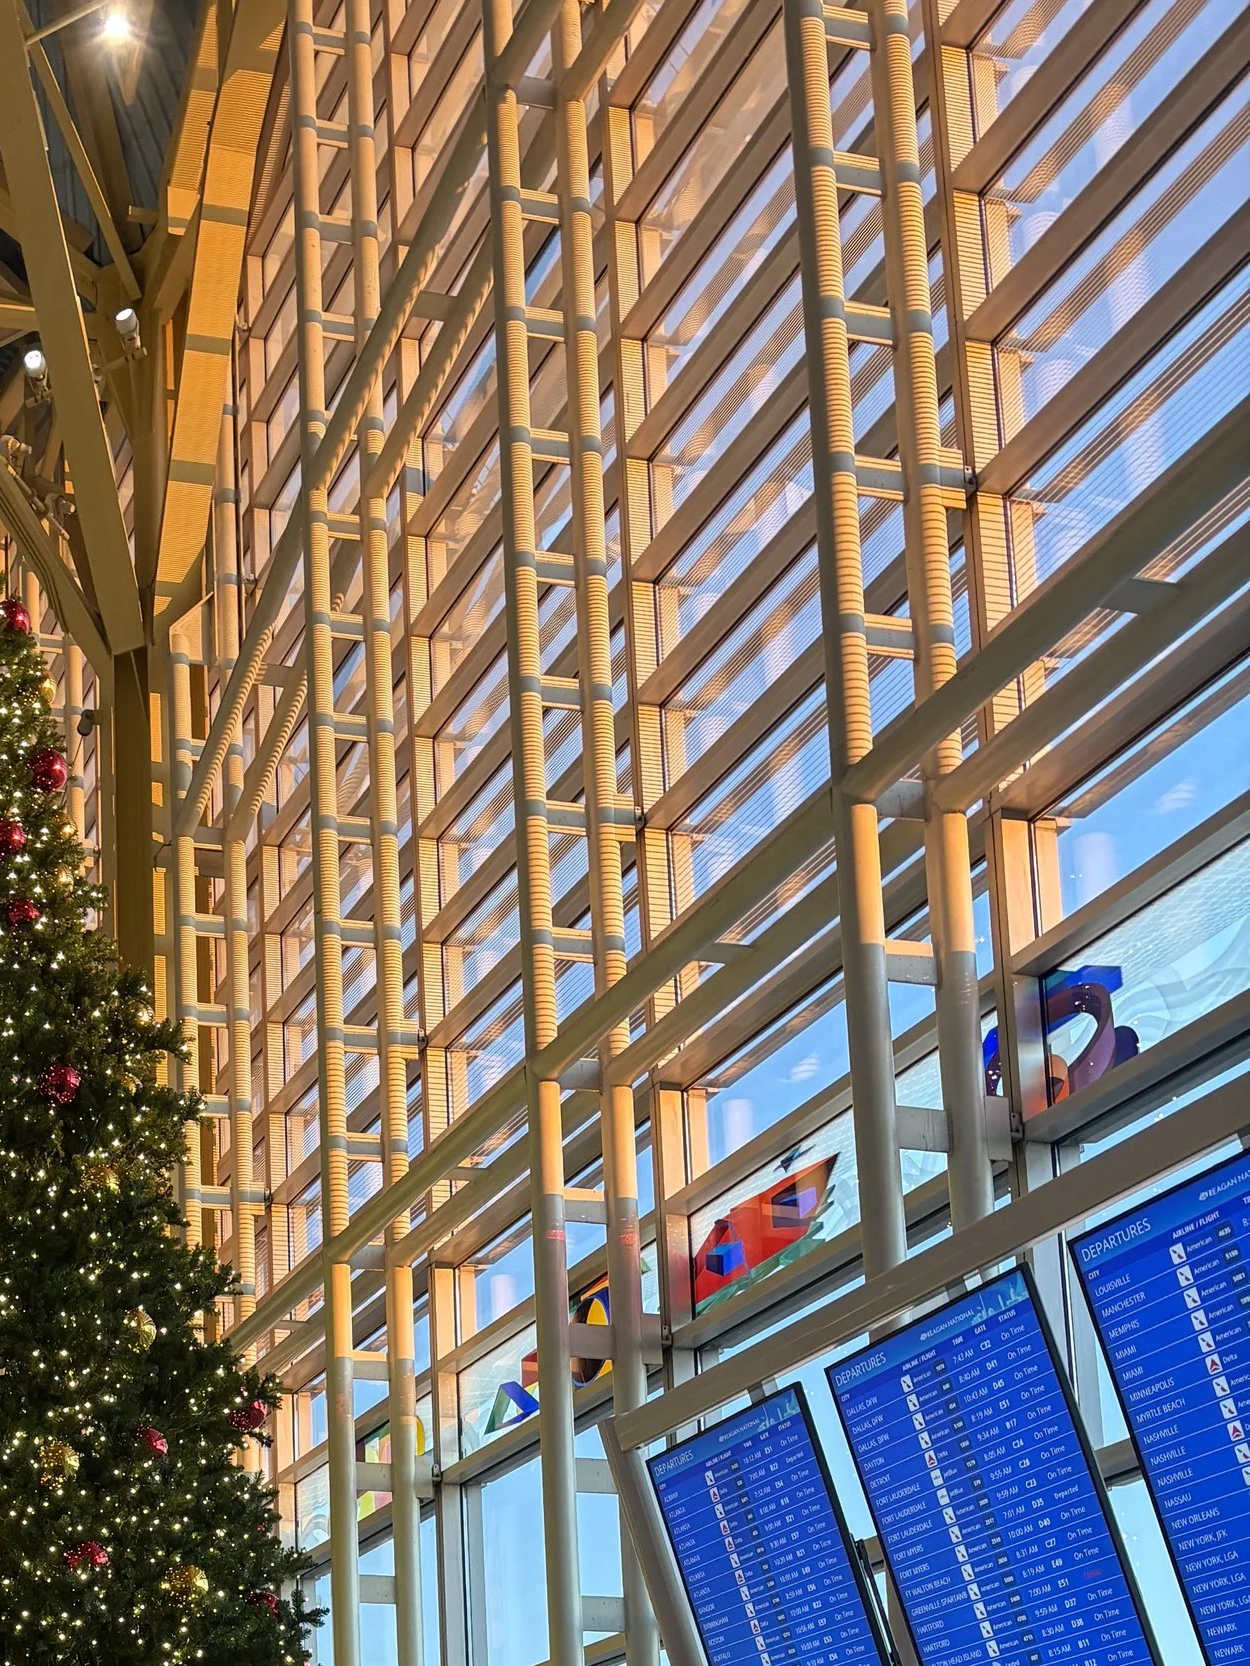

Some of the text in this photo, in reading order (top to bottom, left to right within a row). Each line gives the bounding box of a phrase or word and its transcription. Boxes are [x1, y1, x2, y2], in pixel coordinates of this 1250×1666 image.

[1082, 1218, 1151, 1261] DEPARTURES
[1089, 1269, 1100, 1280] CITY
[1172, 1223, 1195, 1239] AIRLINE
[1199, 1211, 1220, 1226] FLIGHT
[1095, 1274, 1131, 1297] LOUISVILLE
[1102, 1292, 1146, 1318] MANCHESTER
[962, 1348, 974, 1359] AM
[979, 1339, 991, 1351] C32
[1000, 1330, 1010, 1341] On
[1009, 1323, 1025, 1336] Time
[1109, 1319, 1140, 1339] MEMPHIS
[1116, 1345, 1137, 1360] MIAMI
[834, 1351, 886, 1386] DEPARTURES
[981, 1406, 993, 1417] AM
[1020, 1389, 1030, 1400] On
[1029, 1383, 1045, 1396] Time
[1130, 1378, 1175, 1402] MINNEAPOLIS
[1136, 1398, 1186, 1424] MYRTLE BEACH
[1144, 1425, 1179, 1445] NASHVILLE
[653, 1449, 694, 1477] DEPARTURES
[1013, 1504, 1025, 1515] AM
[1031, 1497, 1044, 1508] D35
[1053, 1484, 1079, 1500] Departed
[1164, 1492, 1191, 1508] NASSAU
[1172, 1507, 1220, 1530] NEW ORLEANS
[1179, 1538, 1194, 1551] NEW
[1216, 1529, 1228, 1541] JFK
[1207, 1623, 1237, 1637] NEWARK
